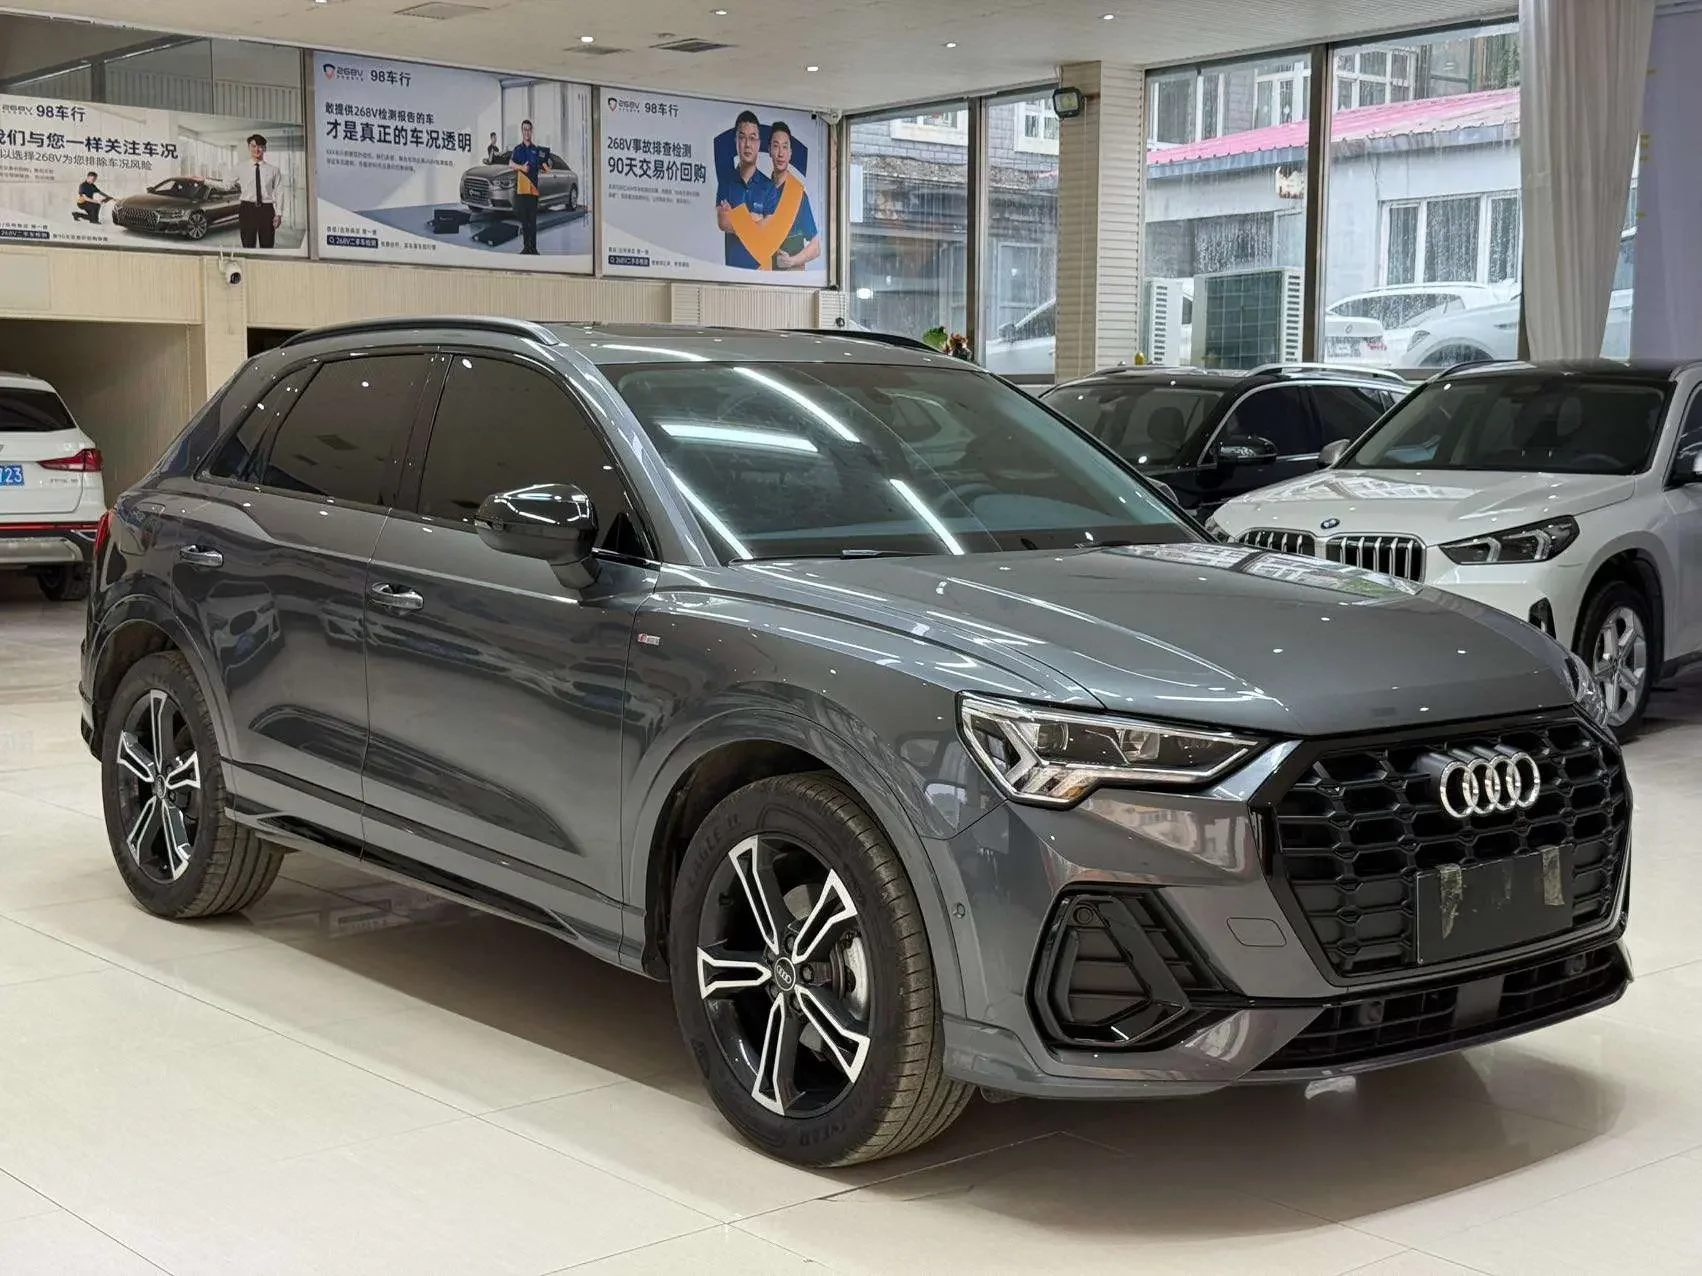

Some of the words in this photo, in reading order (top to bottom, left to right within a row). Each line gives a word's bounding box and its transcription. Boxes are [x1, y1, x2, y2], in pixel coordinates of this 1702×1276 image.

[370, 69, 411, 87] 98车行
[36, 105, 86, 122] 98车行
[325, 102, 434, 125] 敢提供268V检测报告的车
[644, 102, 679, 117] 98车行
[326, 118, 472, 152] 才是真正的车况透明
[607, 137, 692, 159] 268V事故排查检测
[608, 156, 706, 184] 90天交易价回购
